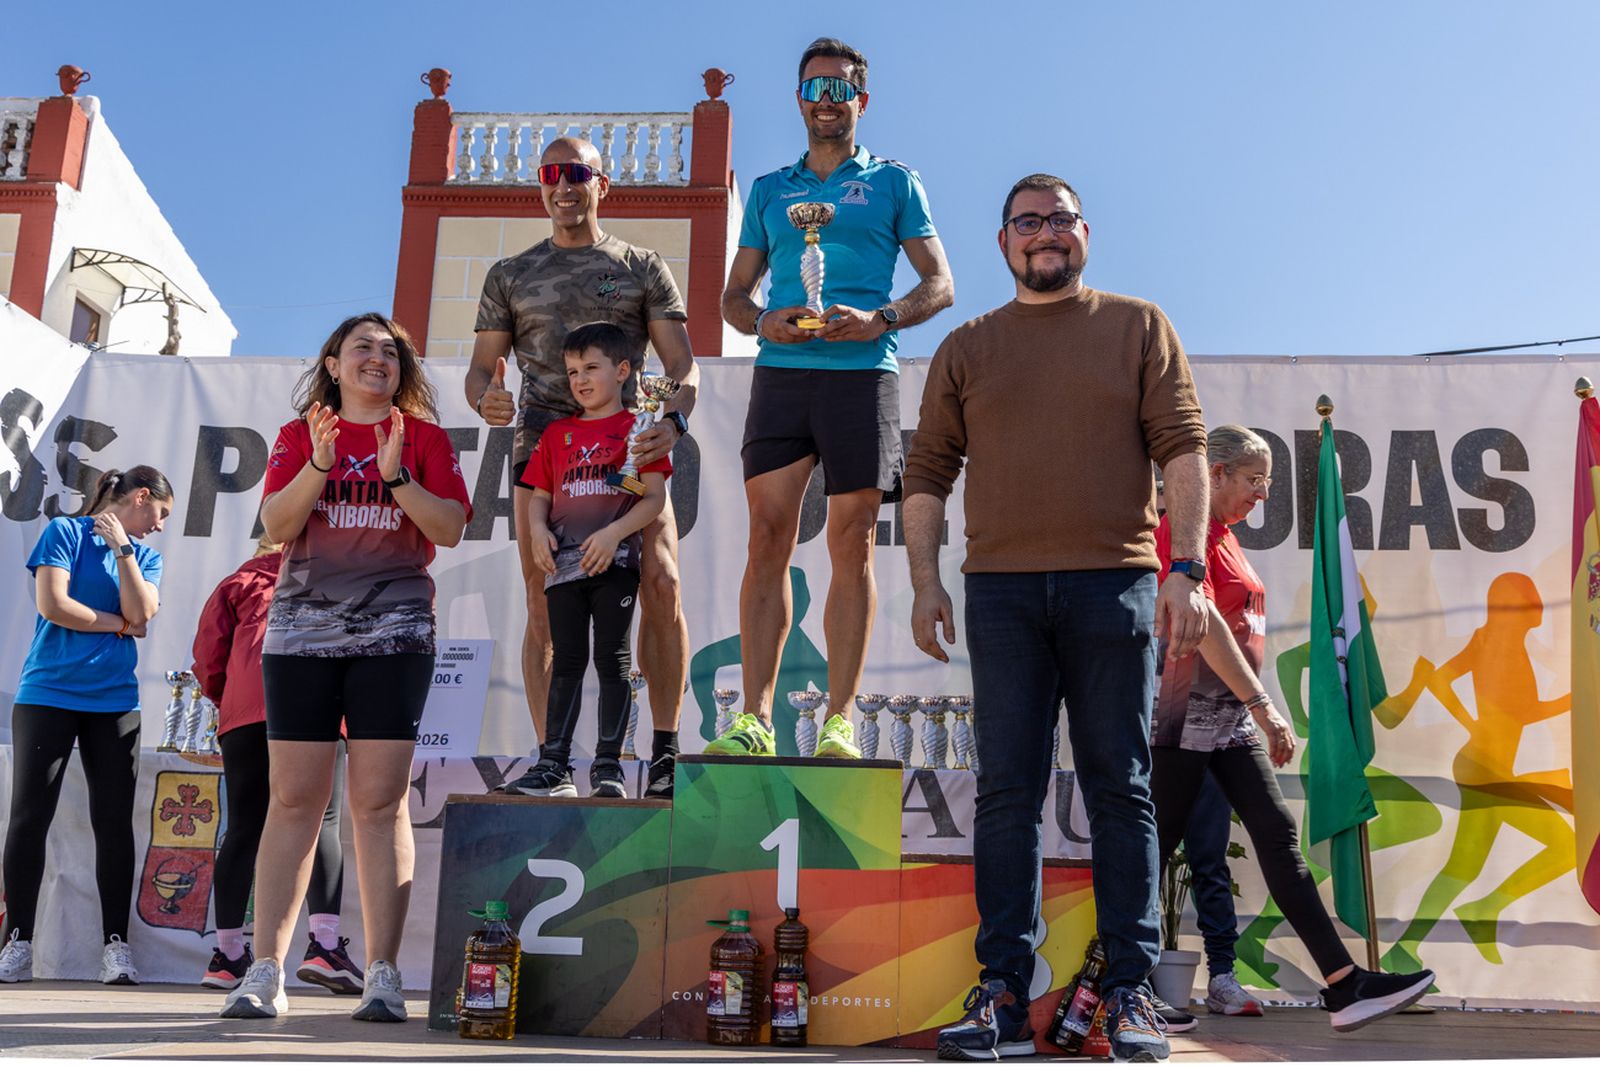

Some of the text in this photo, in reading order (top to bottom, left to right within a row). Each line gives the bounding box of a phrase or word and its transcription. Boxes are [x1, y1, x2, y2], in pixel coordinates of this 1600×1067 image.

[327, 498, 404, 532] VÍBORAS
[454, 673, 464, 685] €
[415, 732, 450, 747] 2026
[759, 817, 800, 912] 1
[517, 858, 586, 956] 2
[810, 996, 892, 1008] DEPORTES
